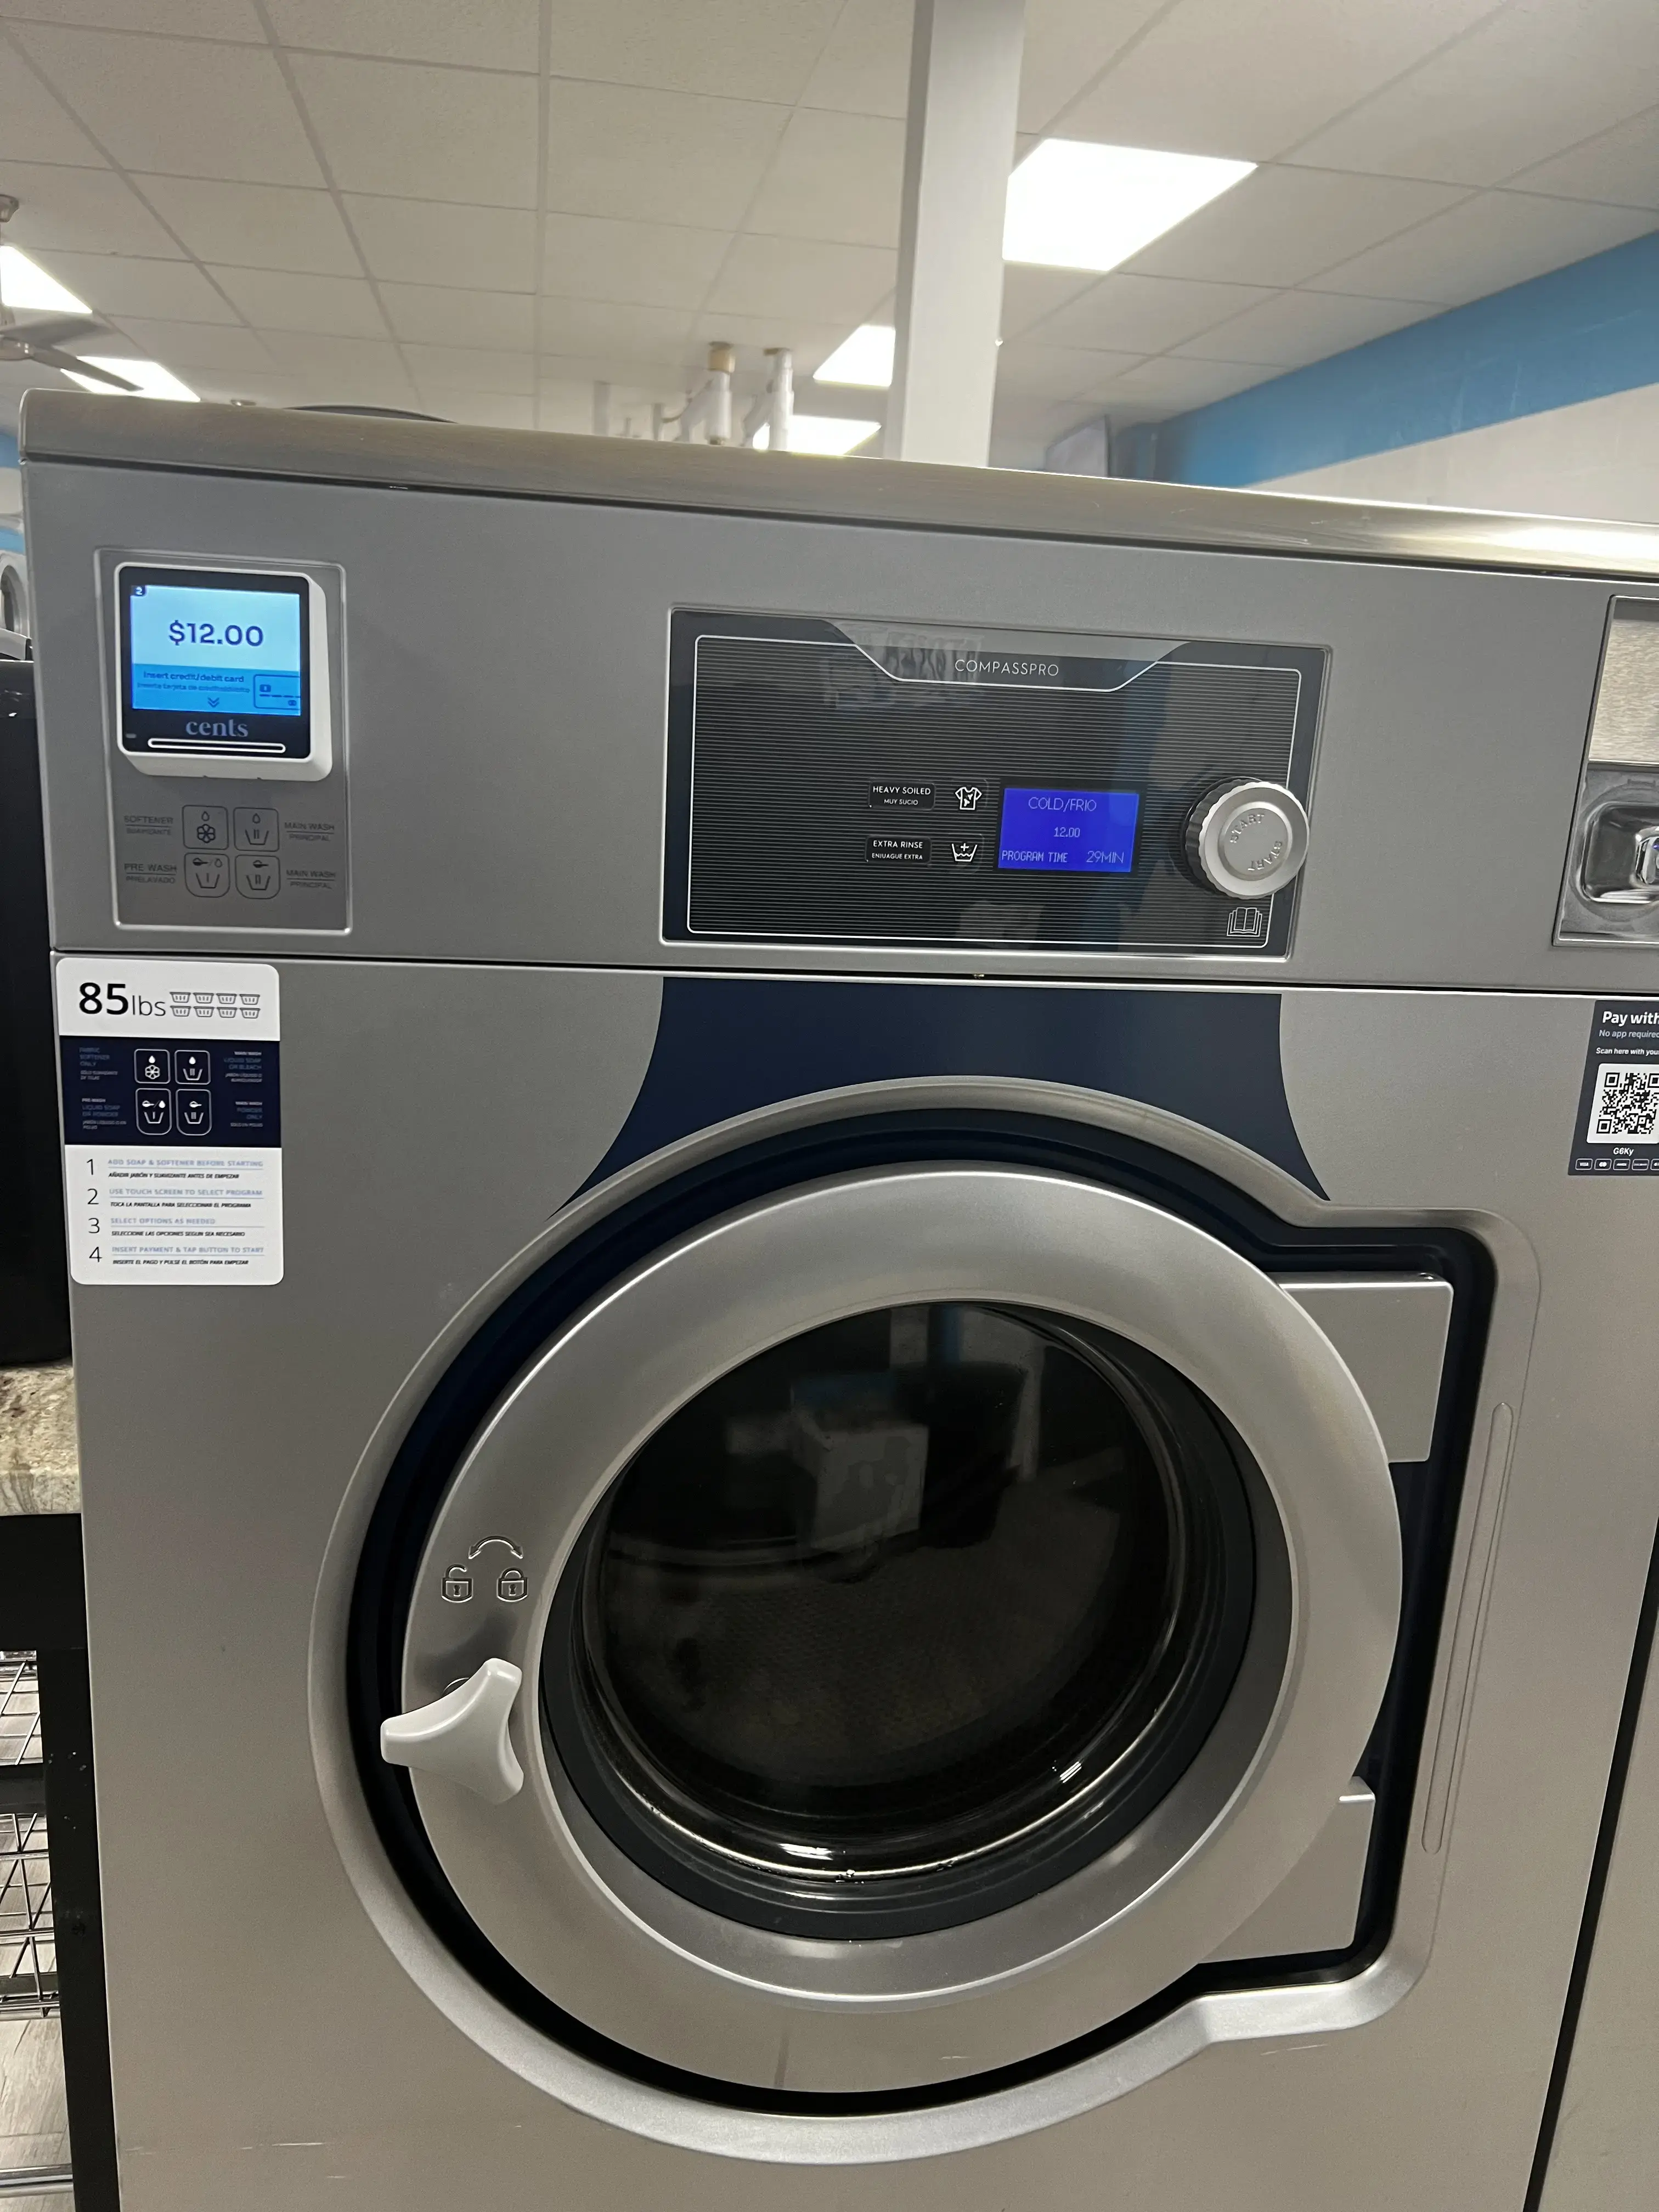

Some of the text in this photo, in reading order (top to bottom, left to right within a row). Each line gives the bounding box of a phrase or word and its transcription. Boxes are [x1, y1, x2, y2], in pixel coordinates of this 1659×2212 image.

[136, 587, 143, 595] 2
[169, 620, 263, 646] $12.00
[955, 659, 1059, 676] COMPASSPRO
[186, 719, 249, 737] cents
[873, 786, 931, 795] HEAVY SOILED
[1028, 797, 1097, 812] COLD/FRIO
[124, 815, 173, 824] SOFTENER
[1053, 826, 1080, 838] 12.00
[1229, 814, 1265, 843] START
[900, 841, 923, 849] RINSE
[1001, 850, 1124, 864] PROGRAM TIME 29MIN
[124, 863, 177, 872] PRE WASH
[1602, 1011, 1659, 1027] Pay with
[1613, 1147, 1634, 1156] G6Ky
[87, 1159, 94, 1175] 1
[87, 1189, 99, 1205] 2
[88, 1218, 100, 1233] 3
[89, 1246, 103, 1262] 4
